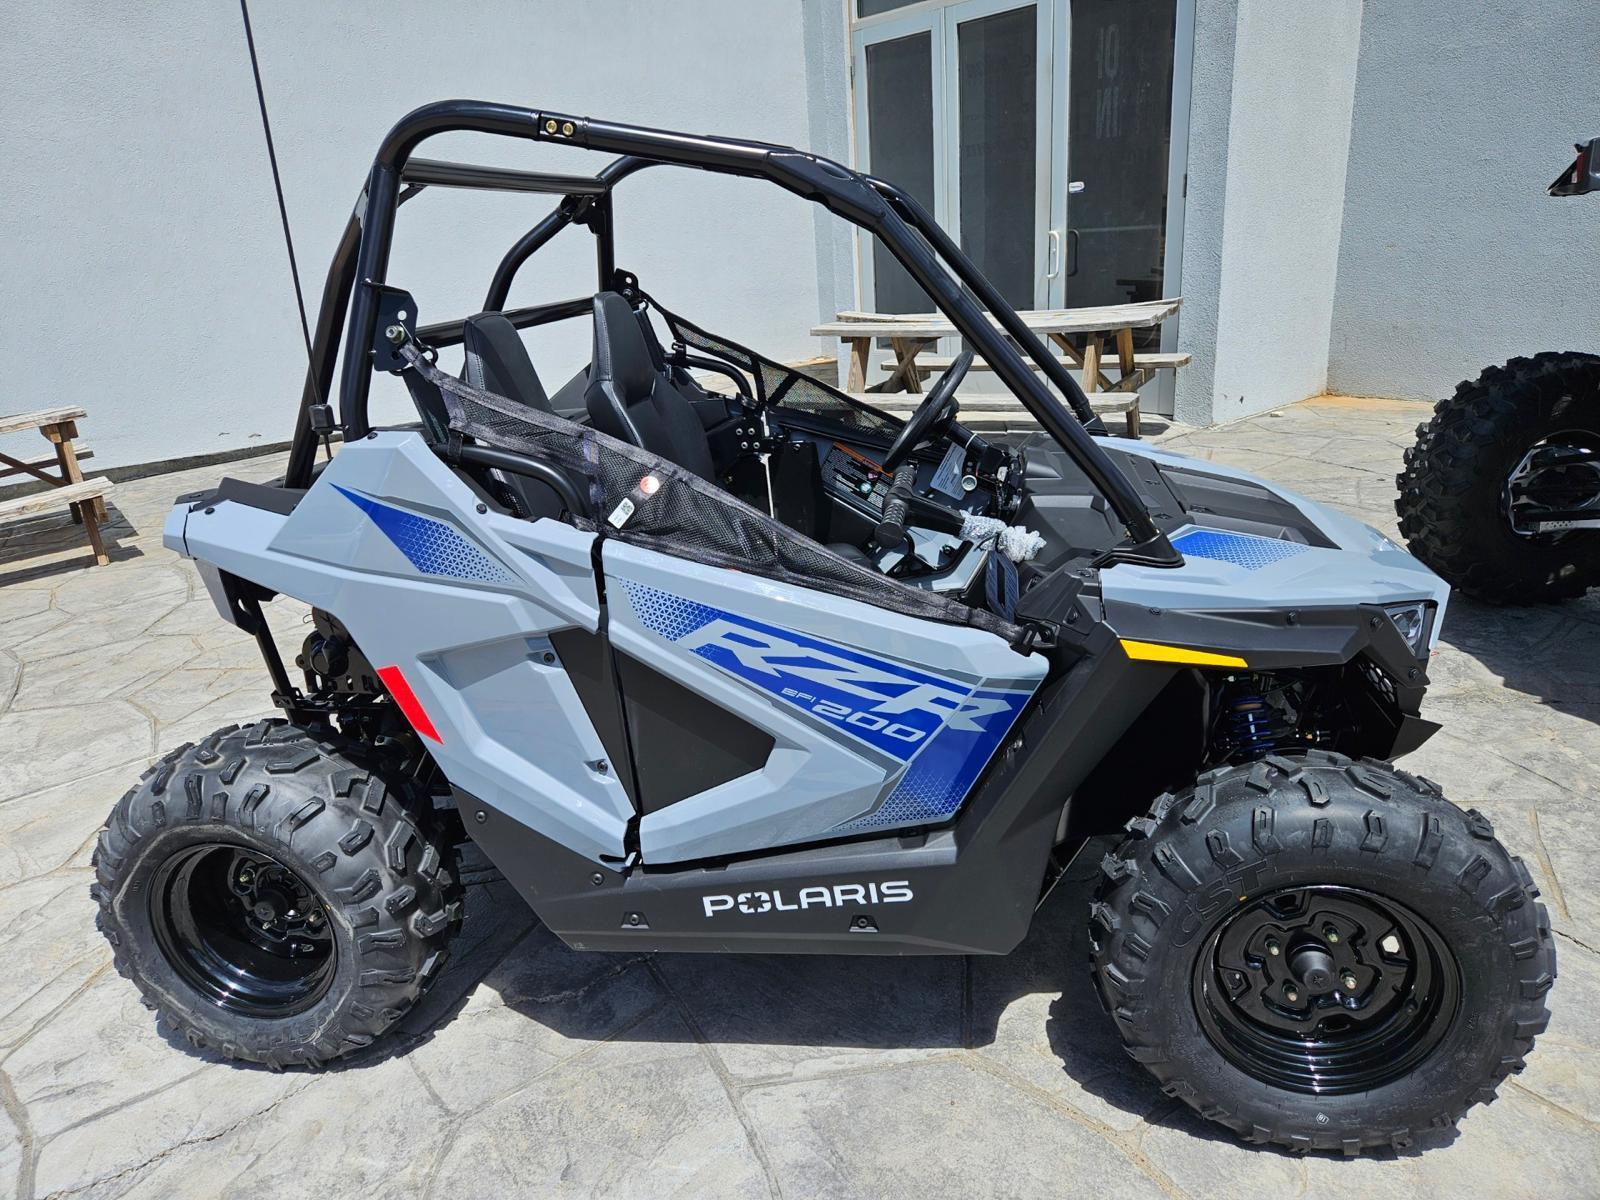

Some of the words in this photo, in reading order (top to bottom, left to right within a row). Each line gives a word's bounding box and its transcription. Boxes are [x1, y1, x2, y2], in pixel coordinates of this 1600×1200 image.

[677, 618, 1013, 732] RZR
[781, 687, 817, 703] EFI
[812, 699, 926, 742] 200
[703, 880, 914, 917] POLARIS
[1171, 859, 1269, 948] CST
